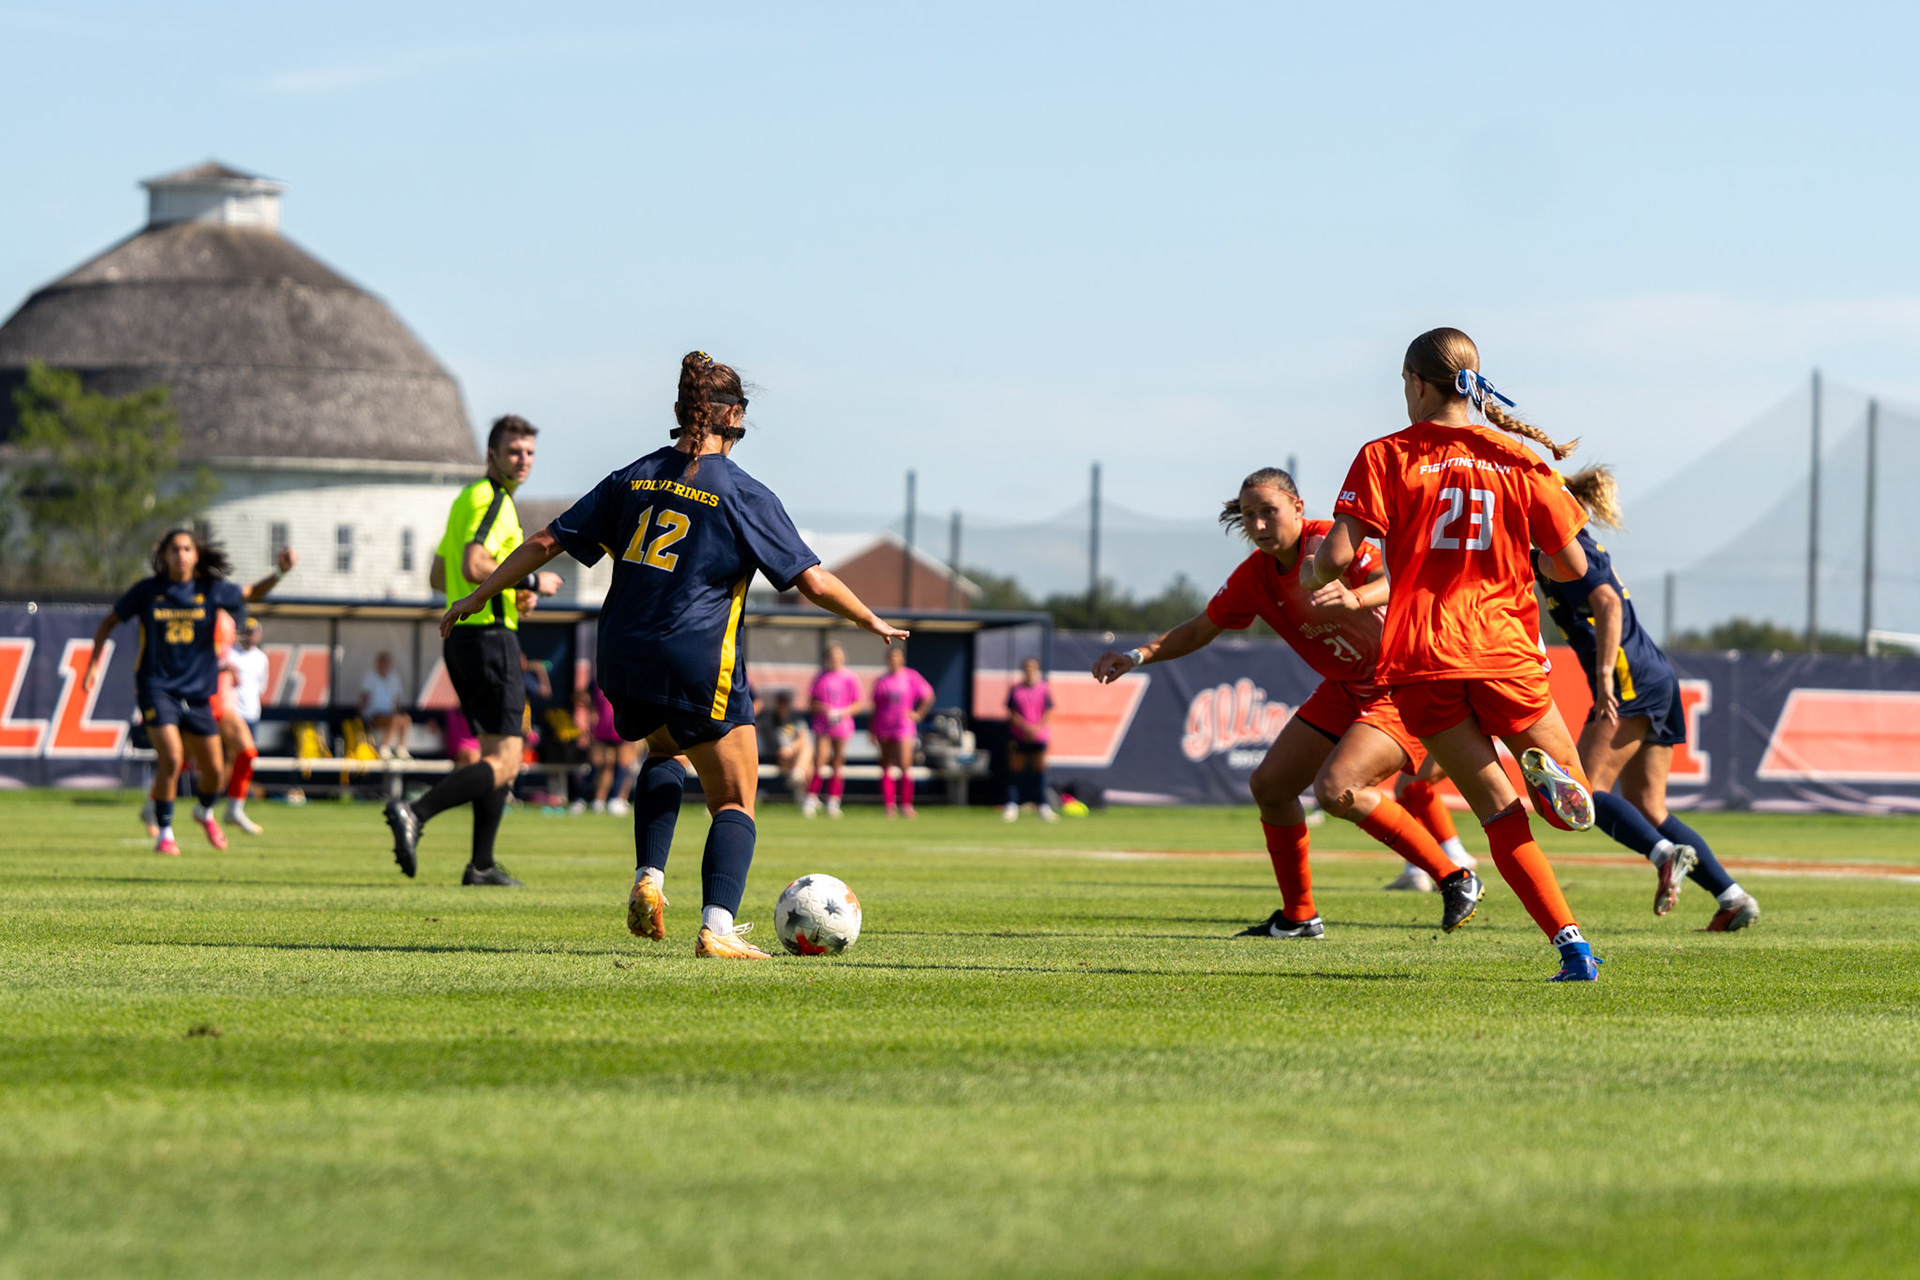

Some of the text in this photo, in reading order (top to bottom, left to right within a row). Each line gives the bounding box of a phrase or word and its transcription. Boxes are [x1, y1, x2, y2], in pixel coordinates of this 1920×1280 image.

[1420, 457, 1475, 475] FIGHTING
[630, 479, 720, 508] WOLVERINES
[1431, 487, 1495, 550] 23
[622, 505, 691, 572] 12
[1323, 634, 1362, 662] 21
